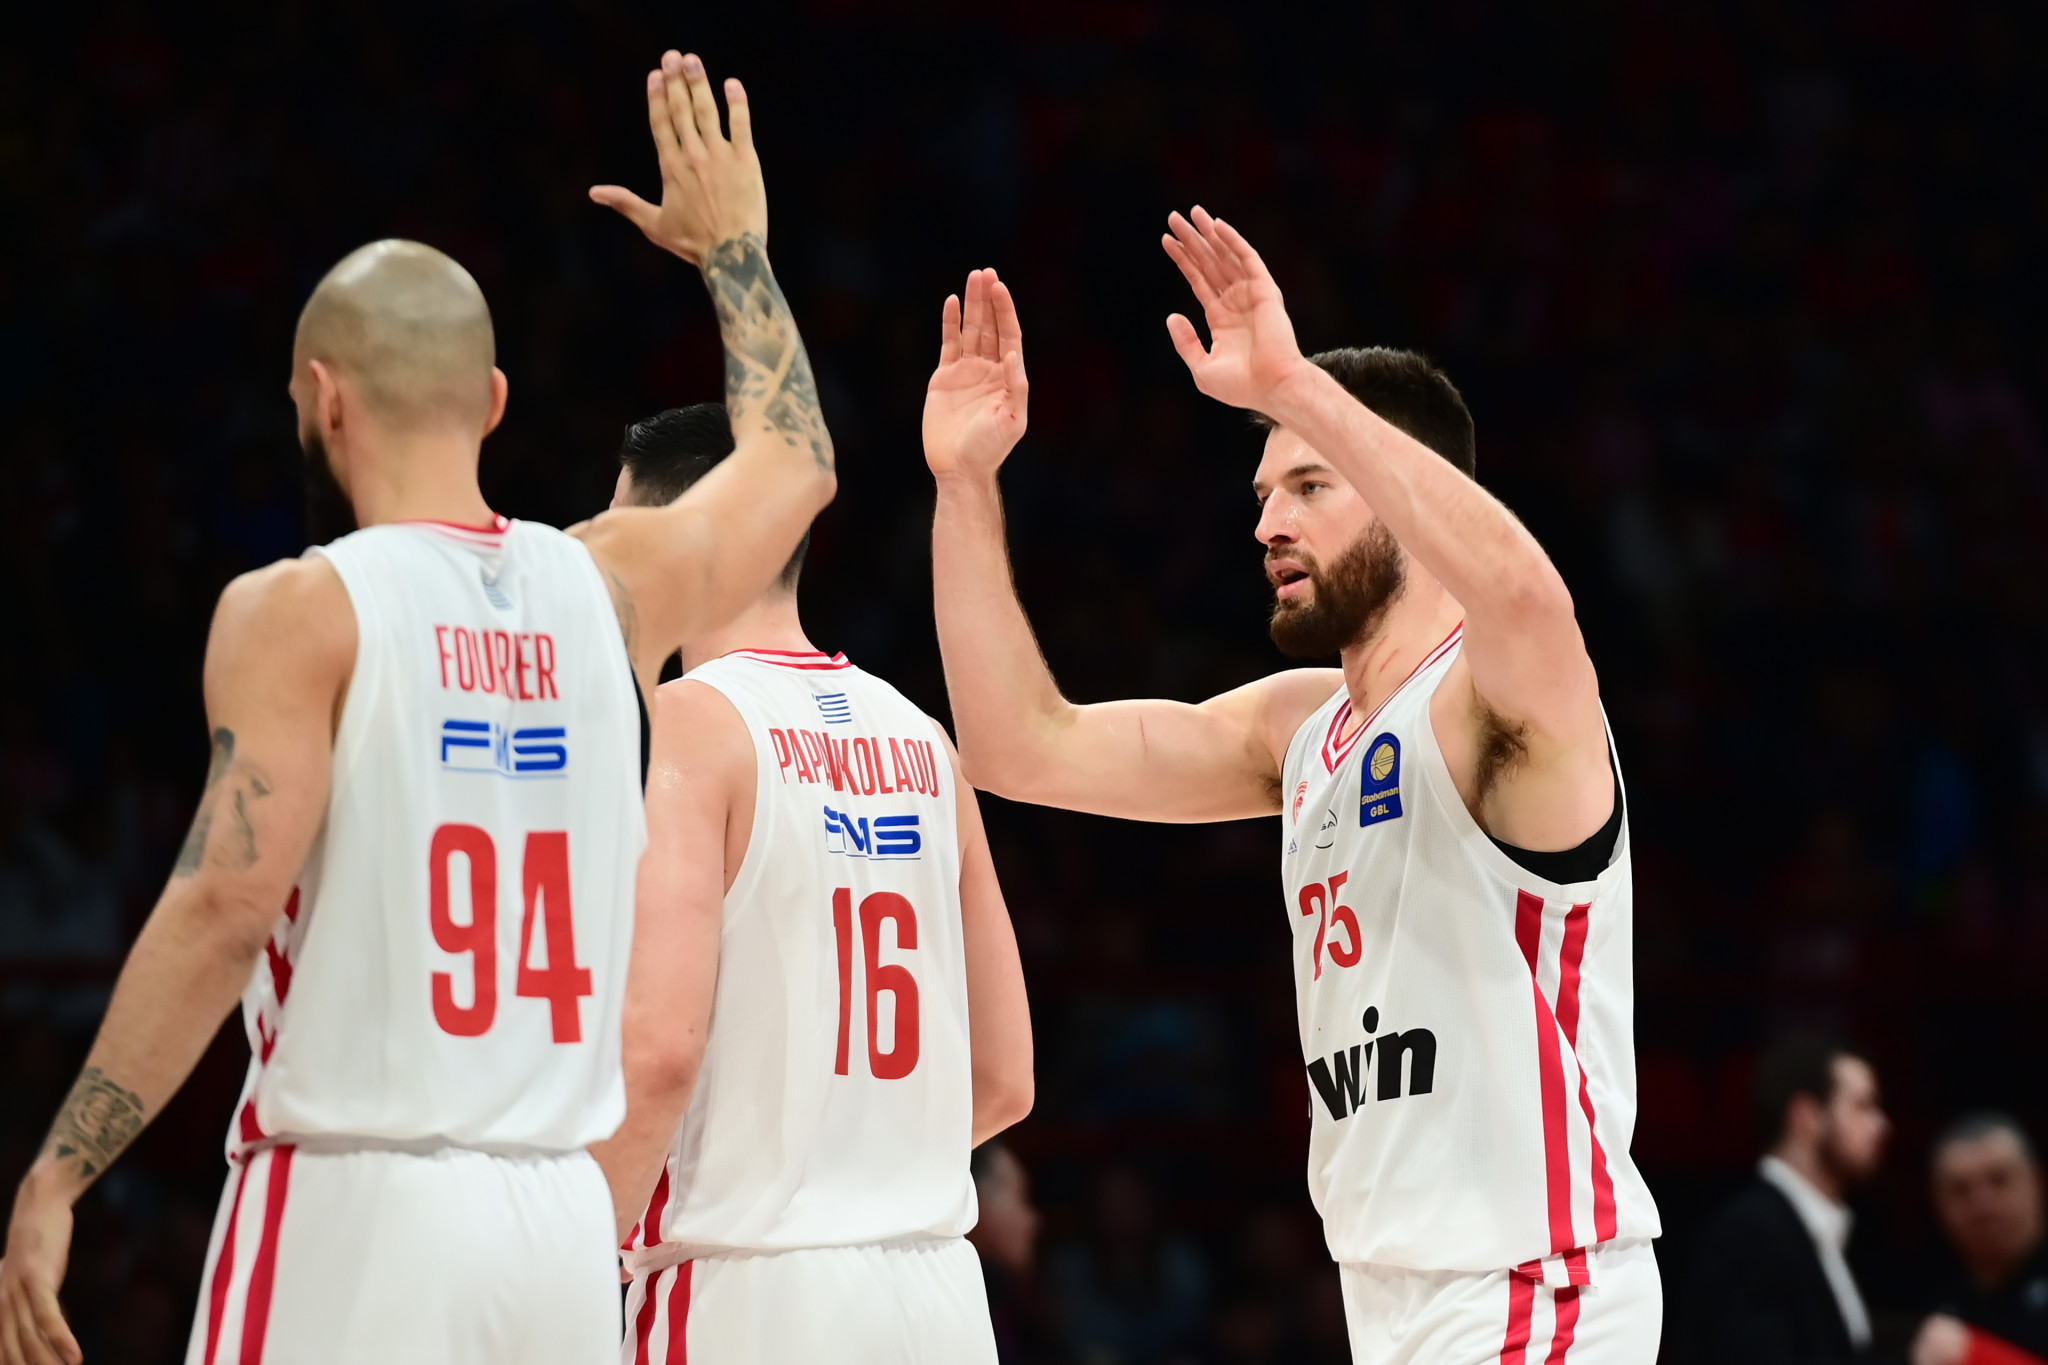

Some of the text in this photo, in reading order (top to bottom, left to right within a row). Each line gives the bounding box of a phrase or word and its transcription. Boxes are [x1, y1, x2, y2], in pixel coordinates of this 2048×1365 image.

[435, 625, 559, 702] FOURER
[824, 805, 921, 855] FMS
[1370, 803, 1390, 817] GBL
[429, 822, 593, 1045] 94
[1299, 870, 1363, 982] 25
[833, 887, 921, 1081] 16
[1308, 1006, 1437, 1131] win
